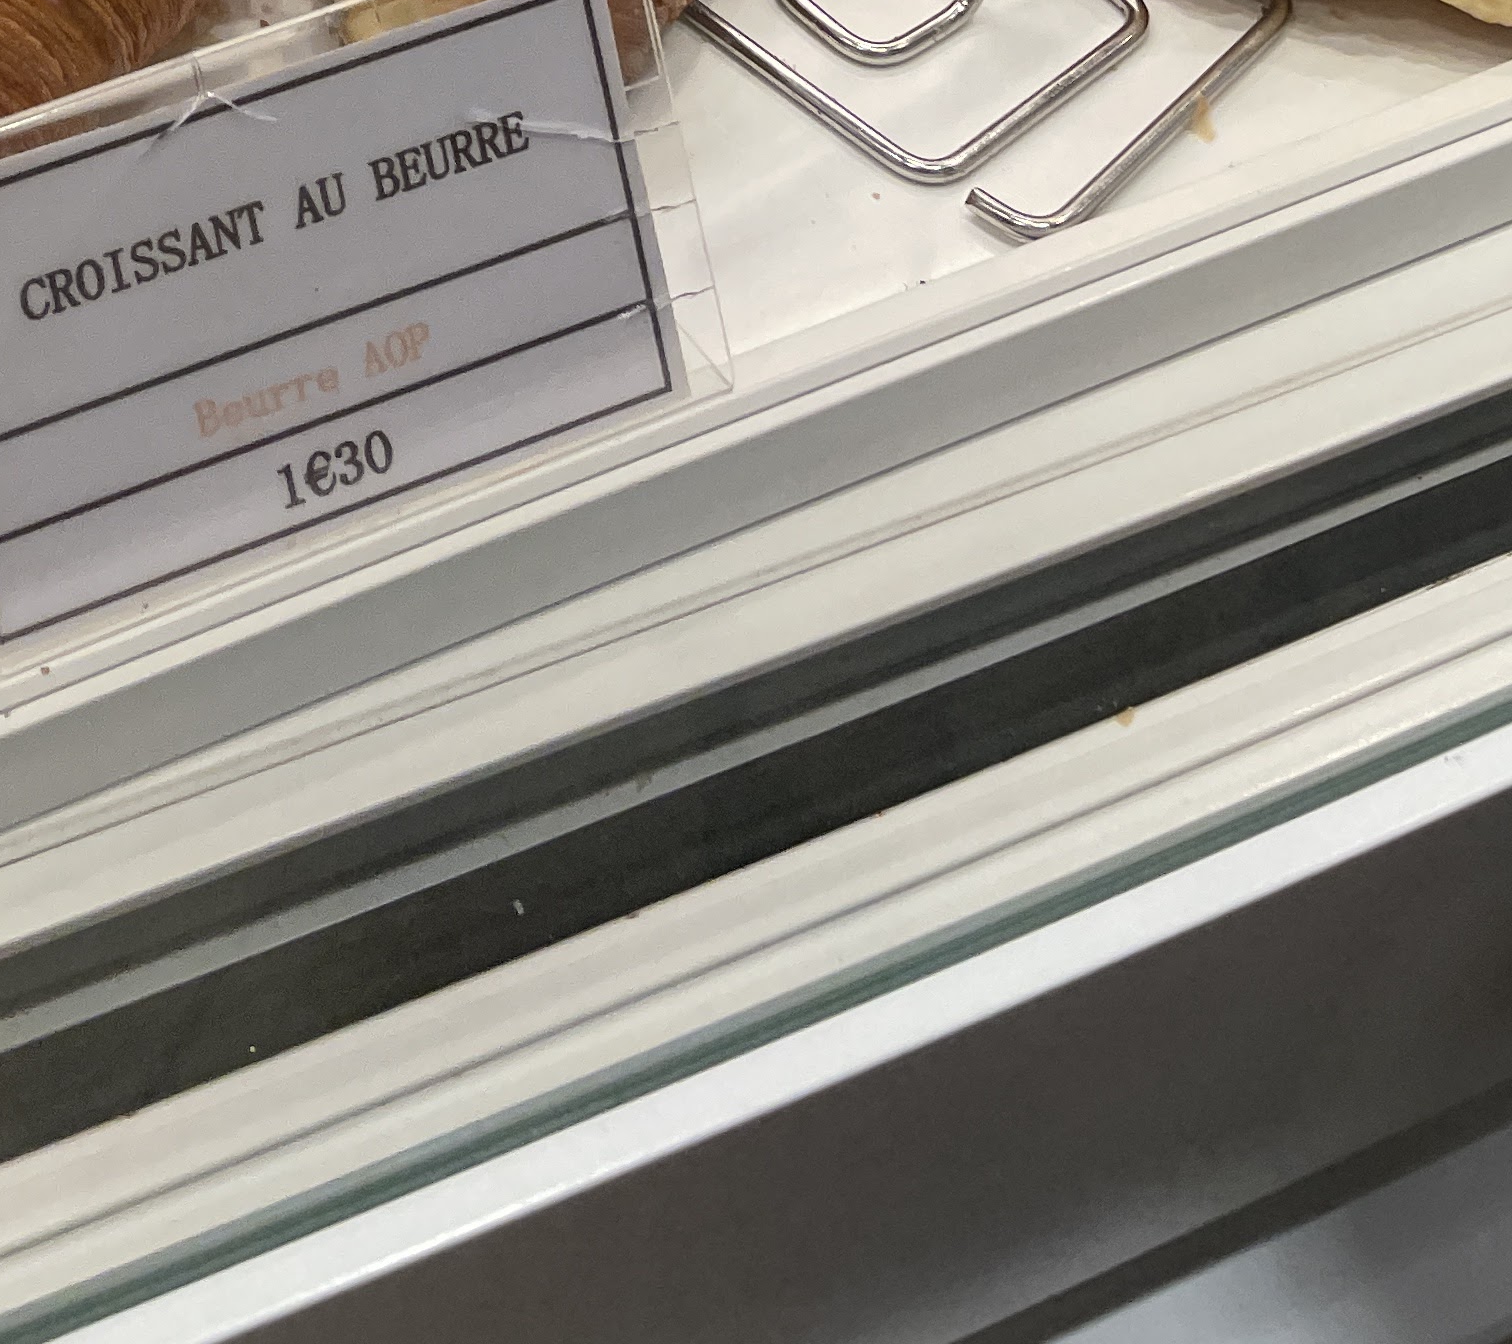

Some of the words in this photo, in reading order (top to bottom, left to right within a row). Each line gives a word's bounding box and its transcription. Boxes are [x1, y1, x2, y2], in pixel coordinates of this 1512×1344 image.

[20, 201, 264, 322] CROISSANT
[295, 172, 348, 231] AU
[369, 112, 531, 202] BEURRE
[192, 363, 341, 440] Beurre
[364, 322, 431, 379] AOP
[277, 429, 394, 511] 1€30
